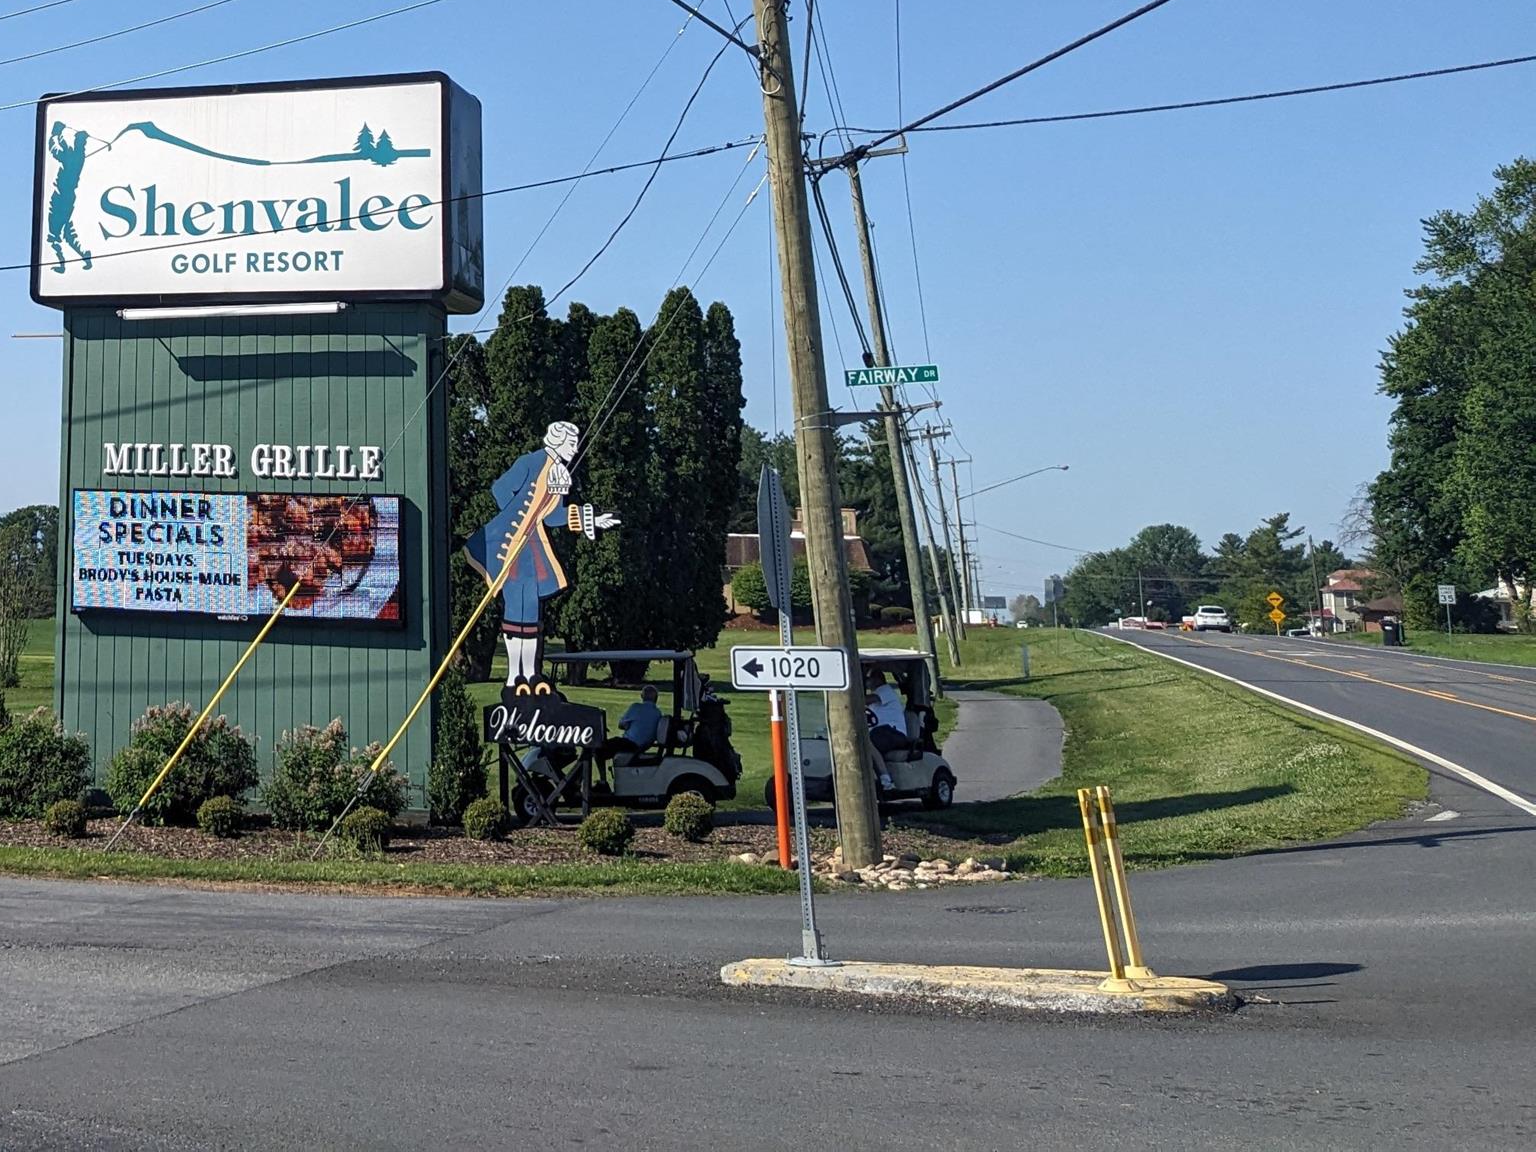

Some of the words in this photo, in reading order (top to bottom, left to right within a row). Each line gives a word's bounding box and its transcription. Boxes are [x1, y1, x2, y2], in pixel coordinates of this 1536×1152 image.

[98, 176, 434, 240] Shenvalee
[171, 252, 237, 274] GOLF
[246, 250, 344, 273] RESORT
[847, 368, 918, 384] FAIRWAY
[923, 369, 936, 378] DR
[103, 443, 236, 476] MILLER
[251, 444, 381, 479] GRILLE
[109, 497, 214, 520] DINNER
[98, 522, 224, 546] SPECIALS
[117, 551, 197, 567] TUESDAYS:
[78, 567, 138, 582] BRODY'S
[143, 570, 241, 586] HOUSE-MADE
[135, 587, 182, 602] PASTA
[1440, 594, 1454, 602] 35
[771, 657, 820, 678] 1020
[490, 705, 594, 744] Welcome
